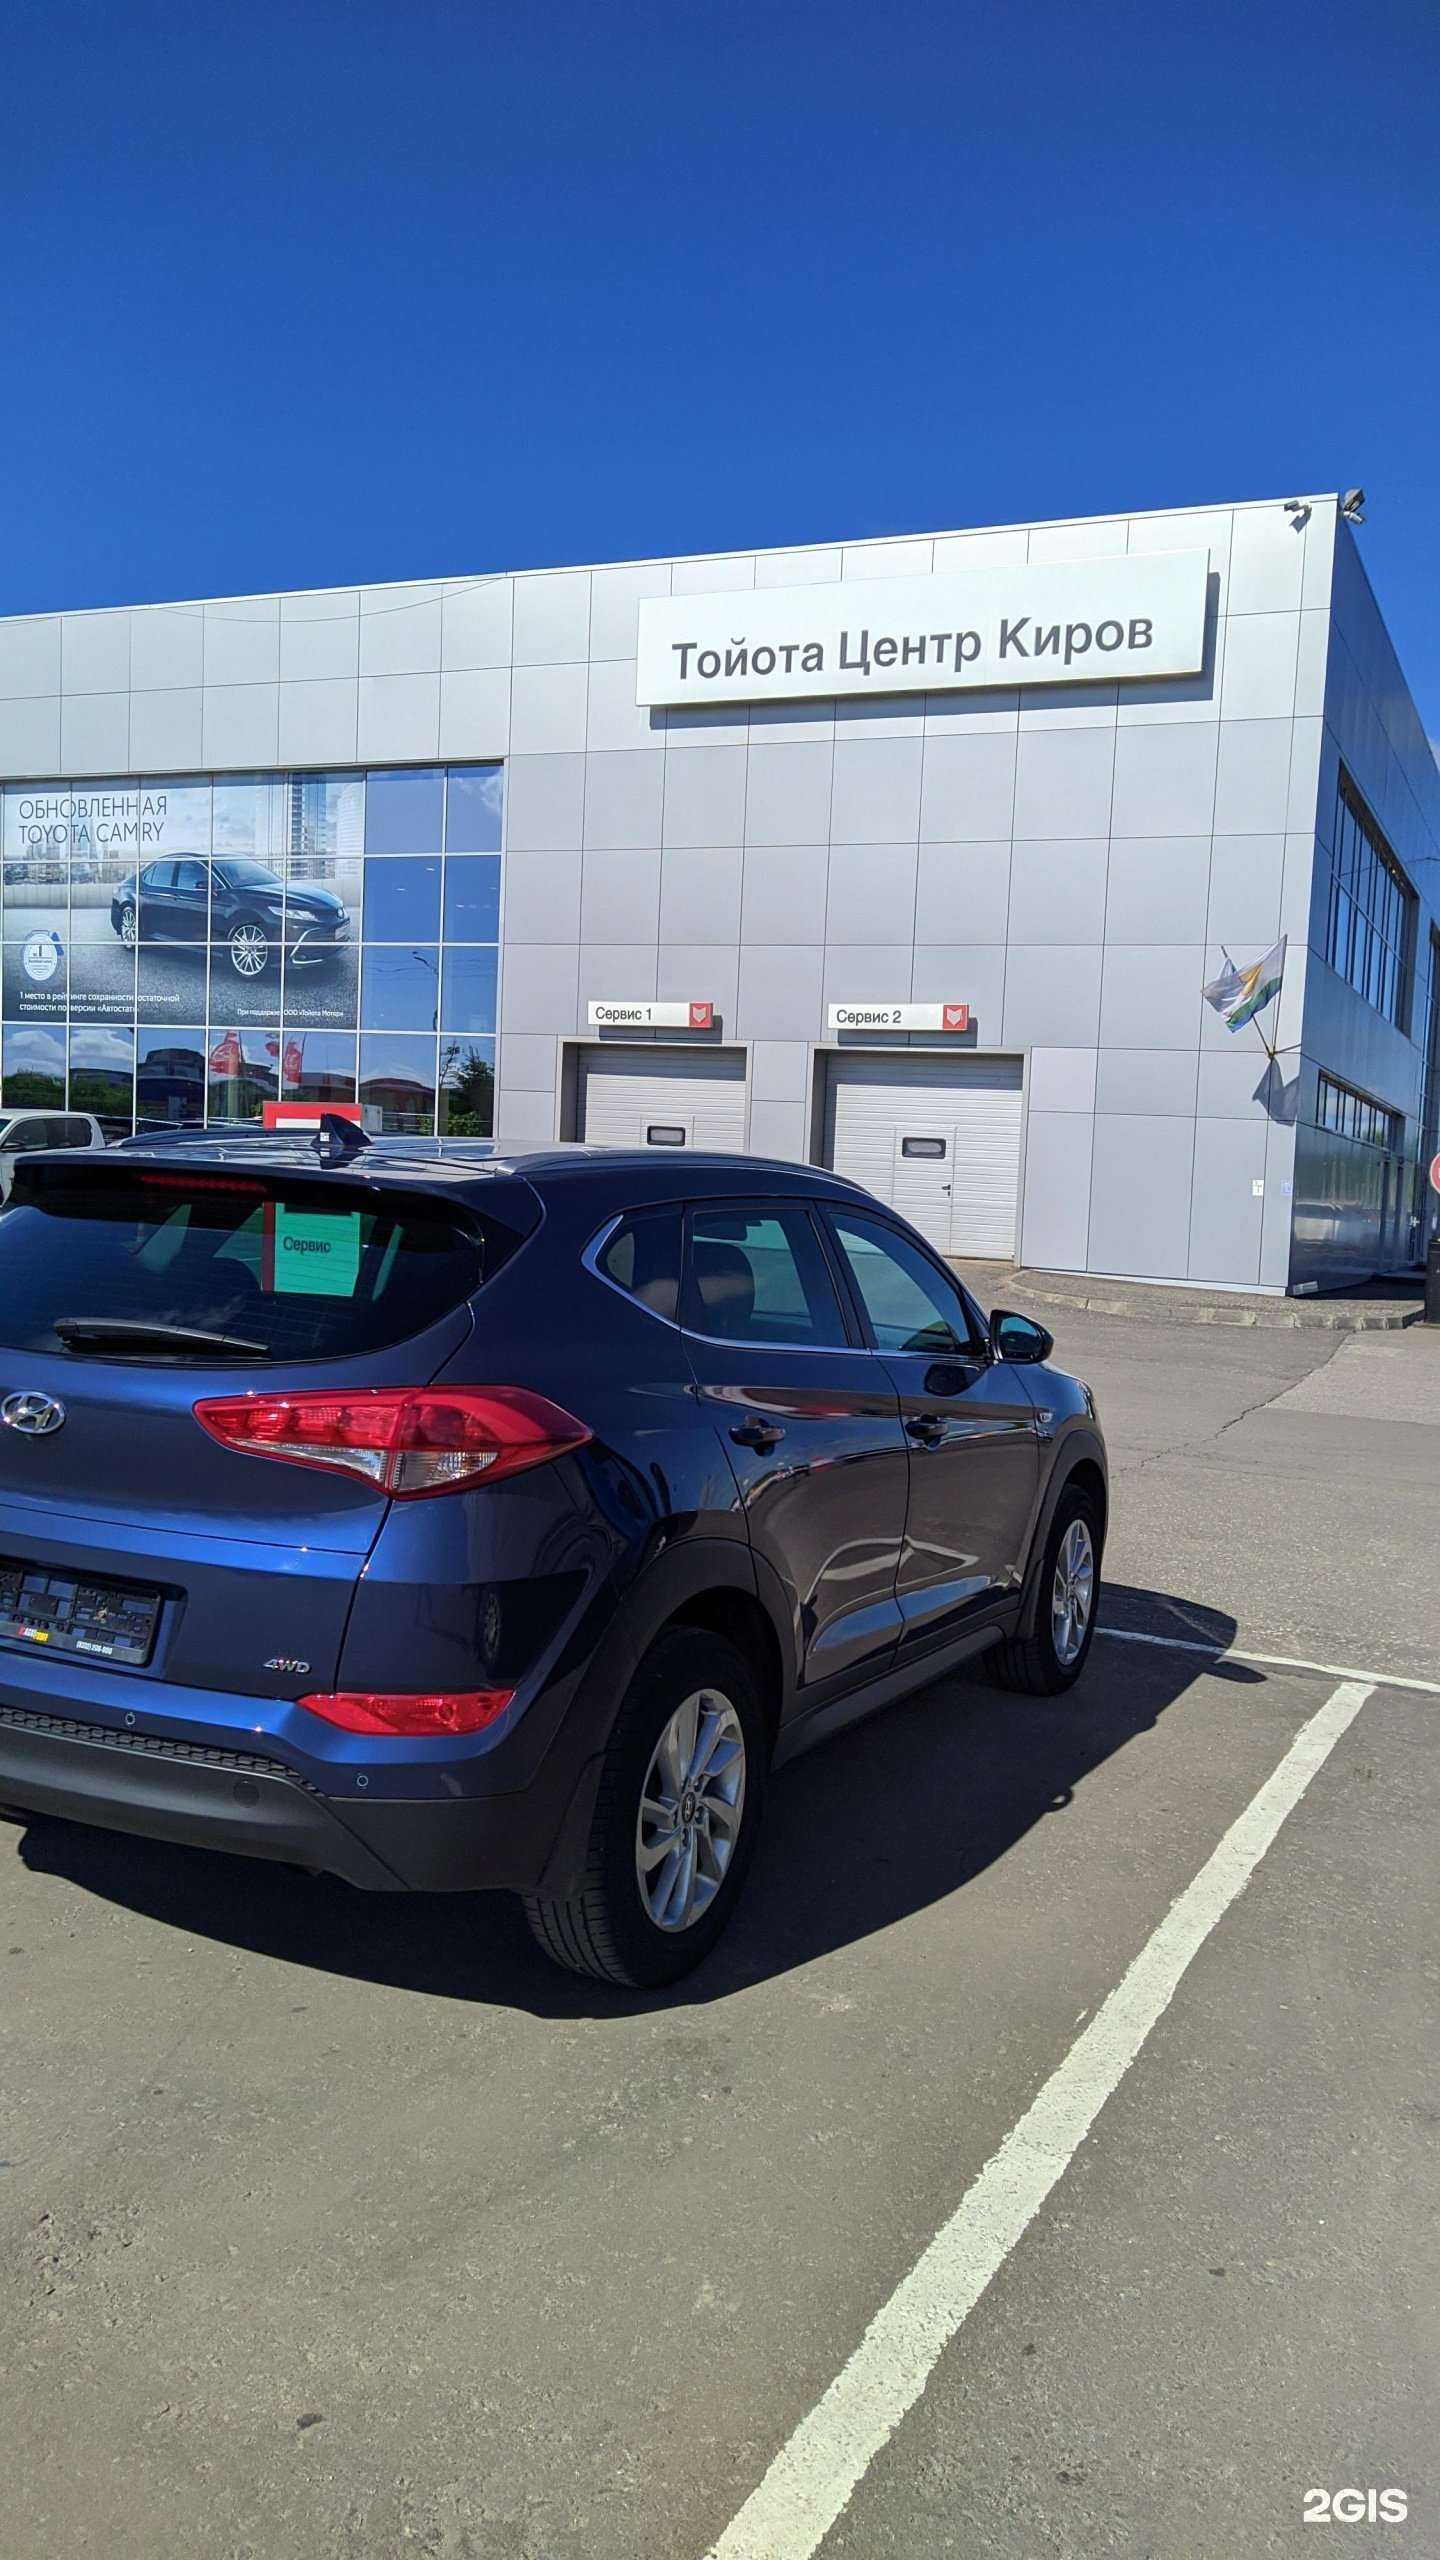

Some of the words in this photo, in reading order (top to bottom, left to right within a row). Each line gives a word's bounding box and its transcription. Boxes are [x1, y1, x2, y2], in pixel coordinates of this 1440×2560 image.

[671, 636, 824, 680] Тойота
[838, 629, 982, 677] Центр
[998, 616, 1154, 666] Киров
[19, 796, 168, 819] ОБНОВЛЕННАЯ
[18, 824, 91, 844] TOYOTA
[96, 822, 165, 843] CAMRY
[595, 1006, 642, 1023] Сервис
[646, 1008, 652, 1021] 1
[836, 1009, 889, 1026] Сервис
[892, 1010, 902, 1024] 2
[283, 1236, 332, 1256] Сервис
[263, 1658, 311, 1673] 4WD
